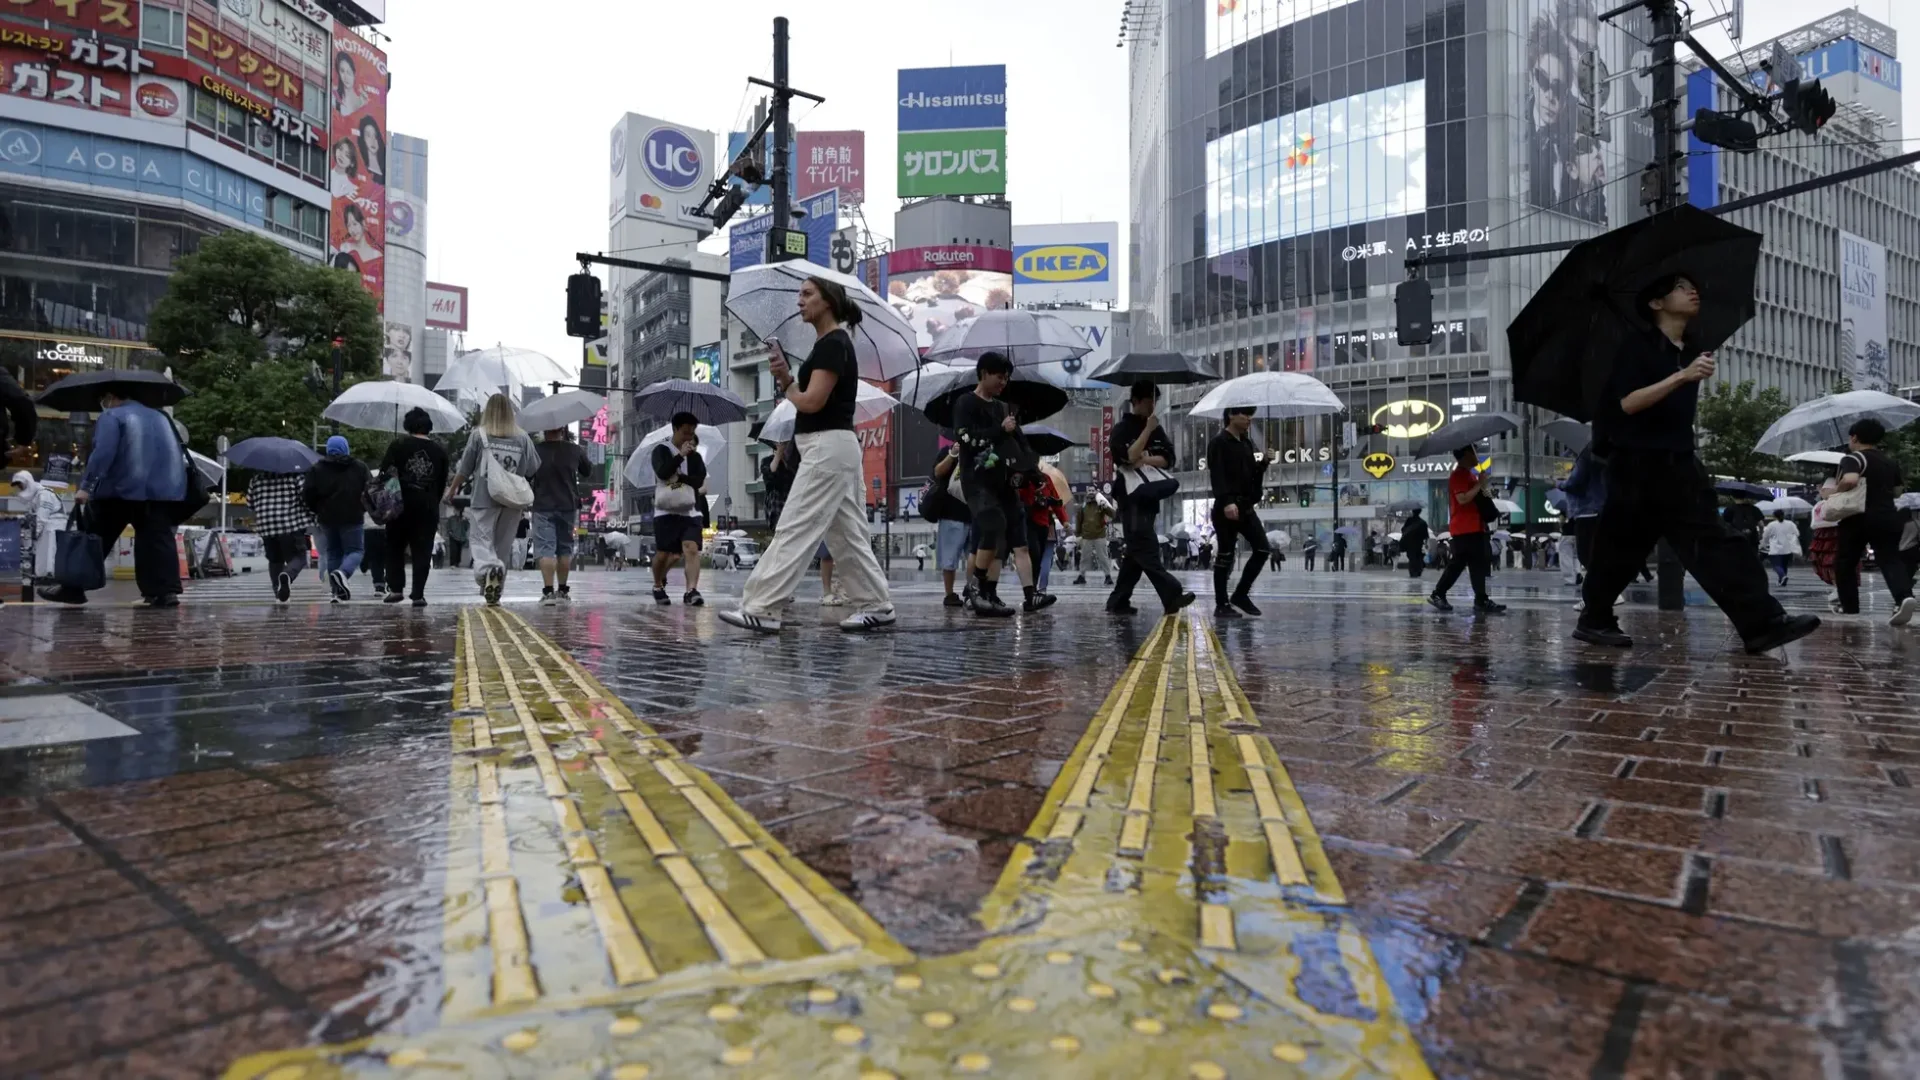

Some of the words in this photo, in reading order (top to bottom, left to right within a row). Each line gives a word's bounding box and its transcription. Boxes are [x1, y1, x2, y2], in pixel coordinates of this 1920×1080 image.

[1, 28, 64, 52] レストラン
[70, 37, 154, 72] ガスト
[187, 20, 299, 97] コンタクト
[334, 38, 387, 76] NOTHING
[12, 62, 121, 109] ガスト
[899, 91, 1005, 108] Hisamitsu
[271, 107, 320, 144] ガスト
[811, 145, 853, 165] 龍角散
[903, 148, 1000, 176] サロンパス
[66, 146, 161, 179] AOBA
[187, 168, 264, 213] CLINIC
[805, 165, 860, 184] ダイレクト
[923, 250, 974, 265] Rakuten
[1022, 254, 1100, 273] IKEA
[1843, 237, 1871, 270] THE
[1843, 263, 1877, 299] LAST
